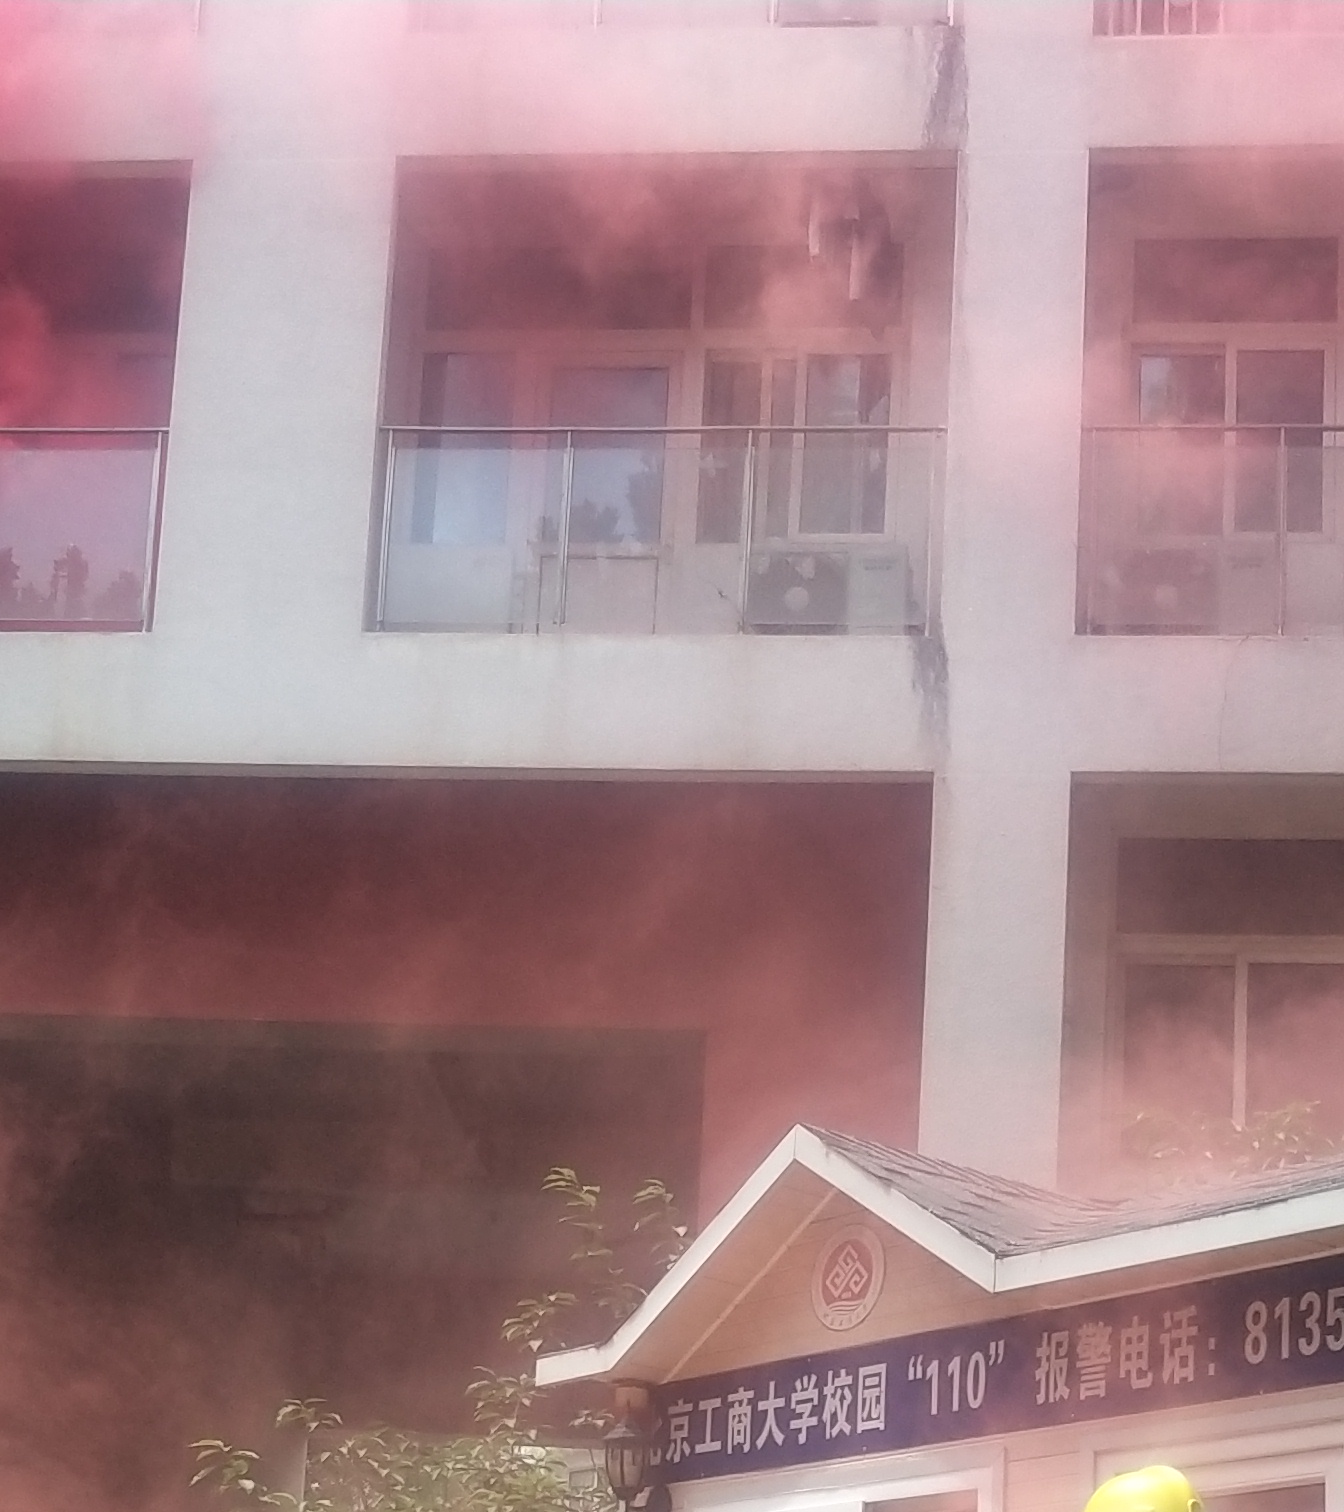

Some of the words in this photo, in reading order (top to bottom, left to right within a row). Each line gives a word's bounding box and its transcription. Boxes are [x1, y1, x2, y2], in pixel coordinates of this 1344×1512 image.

[649, 1362, 888, 1467] 京工商大学校园
